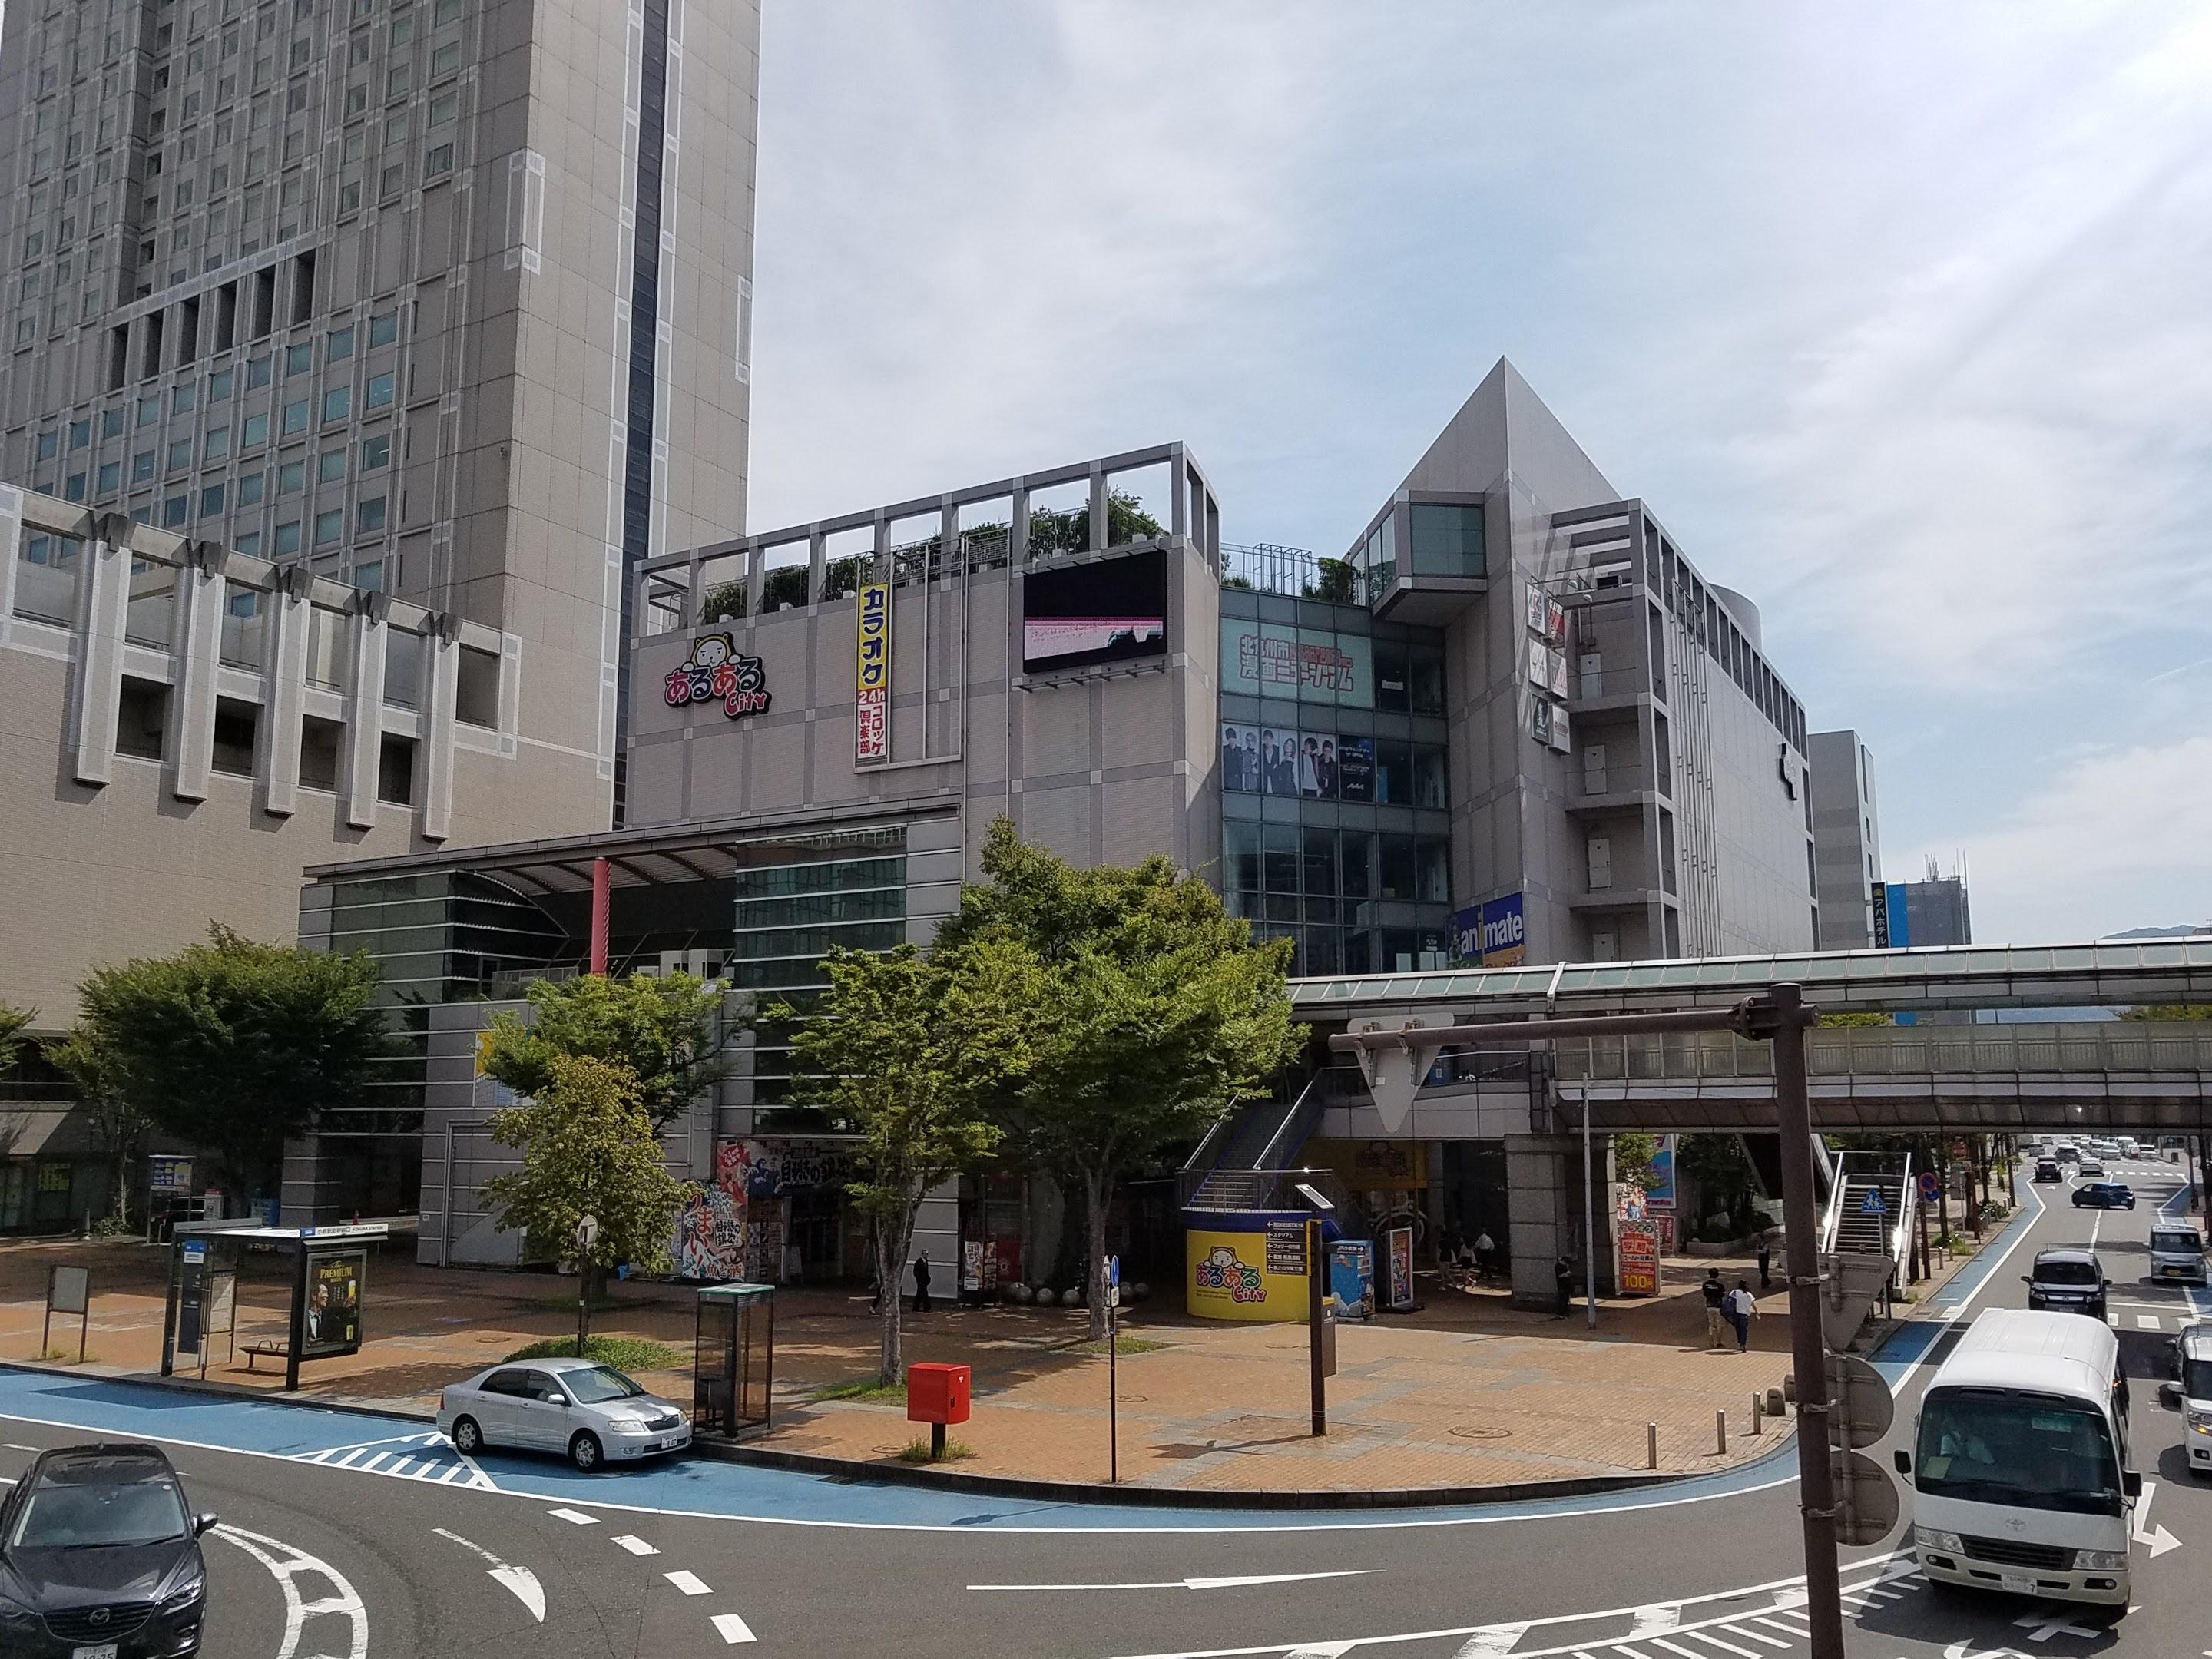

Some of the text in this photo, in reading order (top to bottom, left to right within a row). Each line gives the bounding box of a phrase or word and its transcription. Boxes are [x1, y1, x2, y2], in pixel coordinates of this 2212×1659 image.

[862, 588, 885, 685] カラオケ
[665, 657, 762, 704] あるある
[858, 688, 886, 705] 24h
[871, 704, 884, 756] コロッケ
[1461, 911, 1523, 955] animate
[1874, 899, 1886, 945] アパホテル
[320, 1266, 353, 1279] PREMIUM
[1196, 1263, 1260, 1288] あるある
